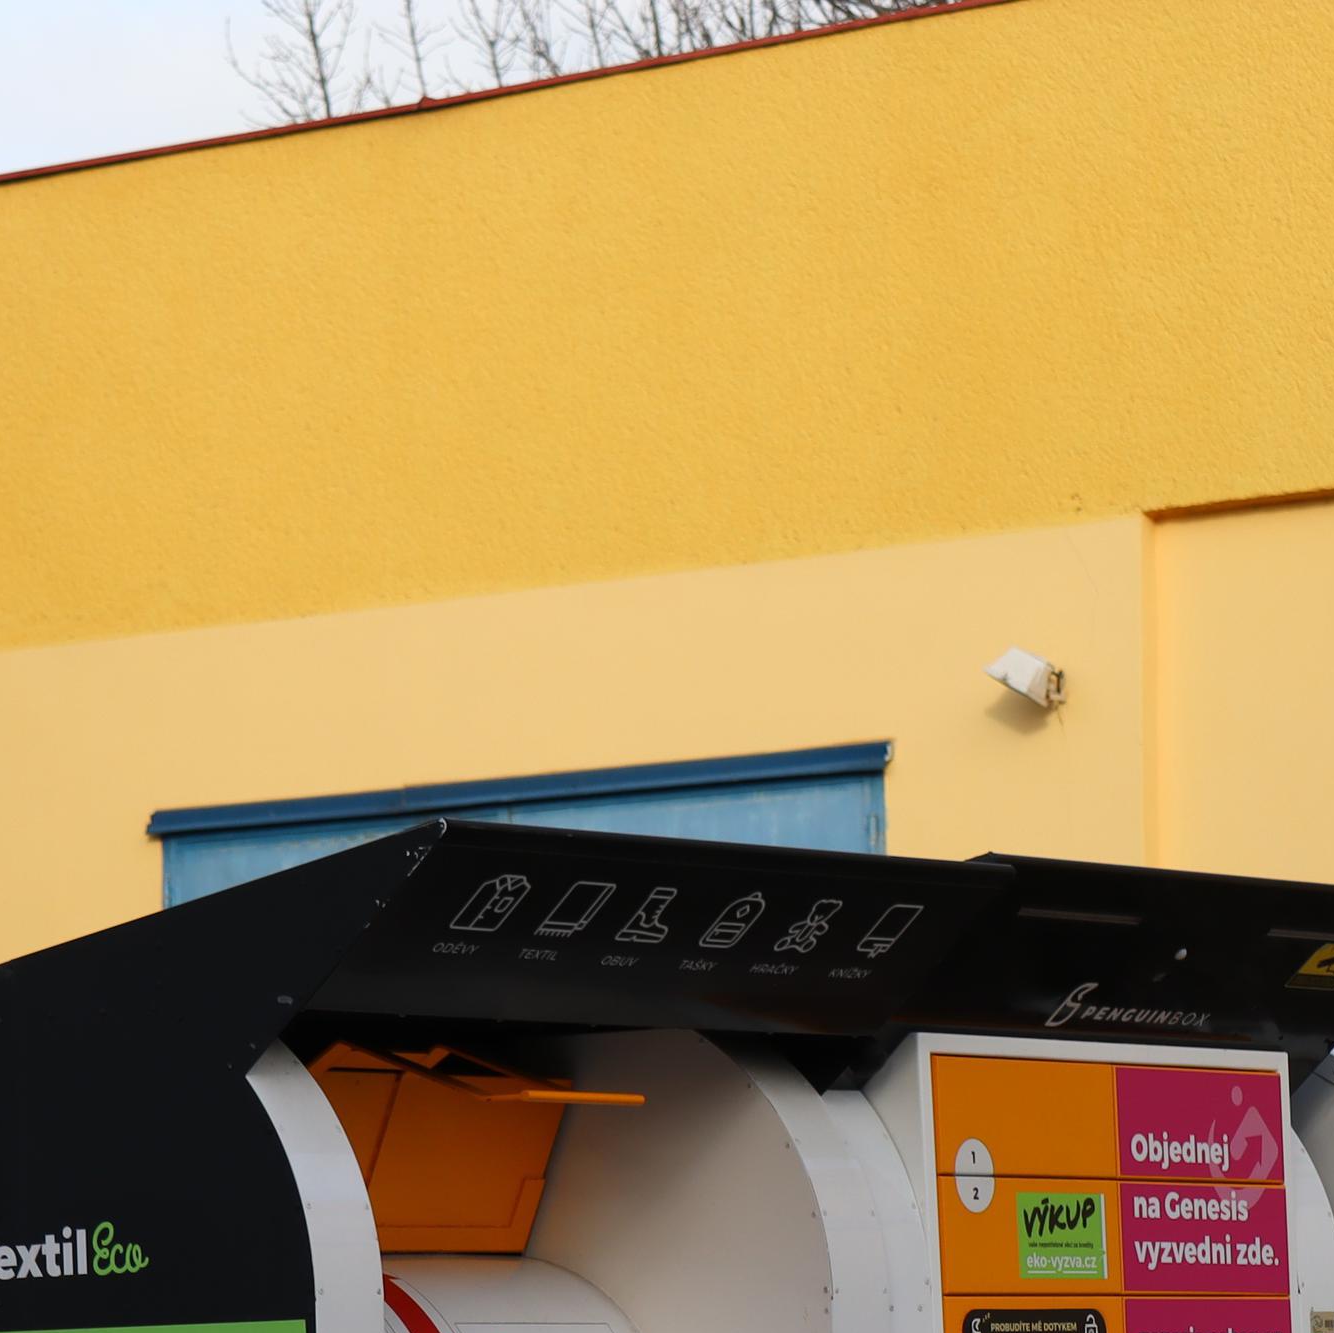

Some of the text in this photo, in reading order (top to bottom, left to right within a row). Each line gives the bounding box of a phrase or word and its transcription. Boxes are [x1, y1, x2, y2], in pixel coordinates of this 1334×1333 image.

[518, 948, 558, 961] TEXTIL
[600, 955, 640, 967] OBUV
[970, 1151, 976, 1164] 1
[1130, 1133, 1230, 1172] Objednej
[973, 1187, 979, 1200] 2
[1134, 1191, 1249, 1222] na Genesis
[1023, 1197, 1095, 1238] VÝKUP
[1027, 1252, 1098, 1271] eko-vyzva.cz
[1135, 1234, 1279, 1270] vyzvedni zde.
[1043, 1322, 1077, 1332] DOTYKEM
